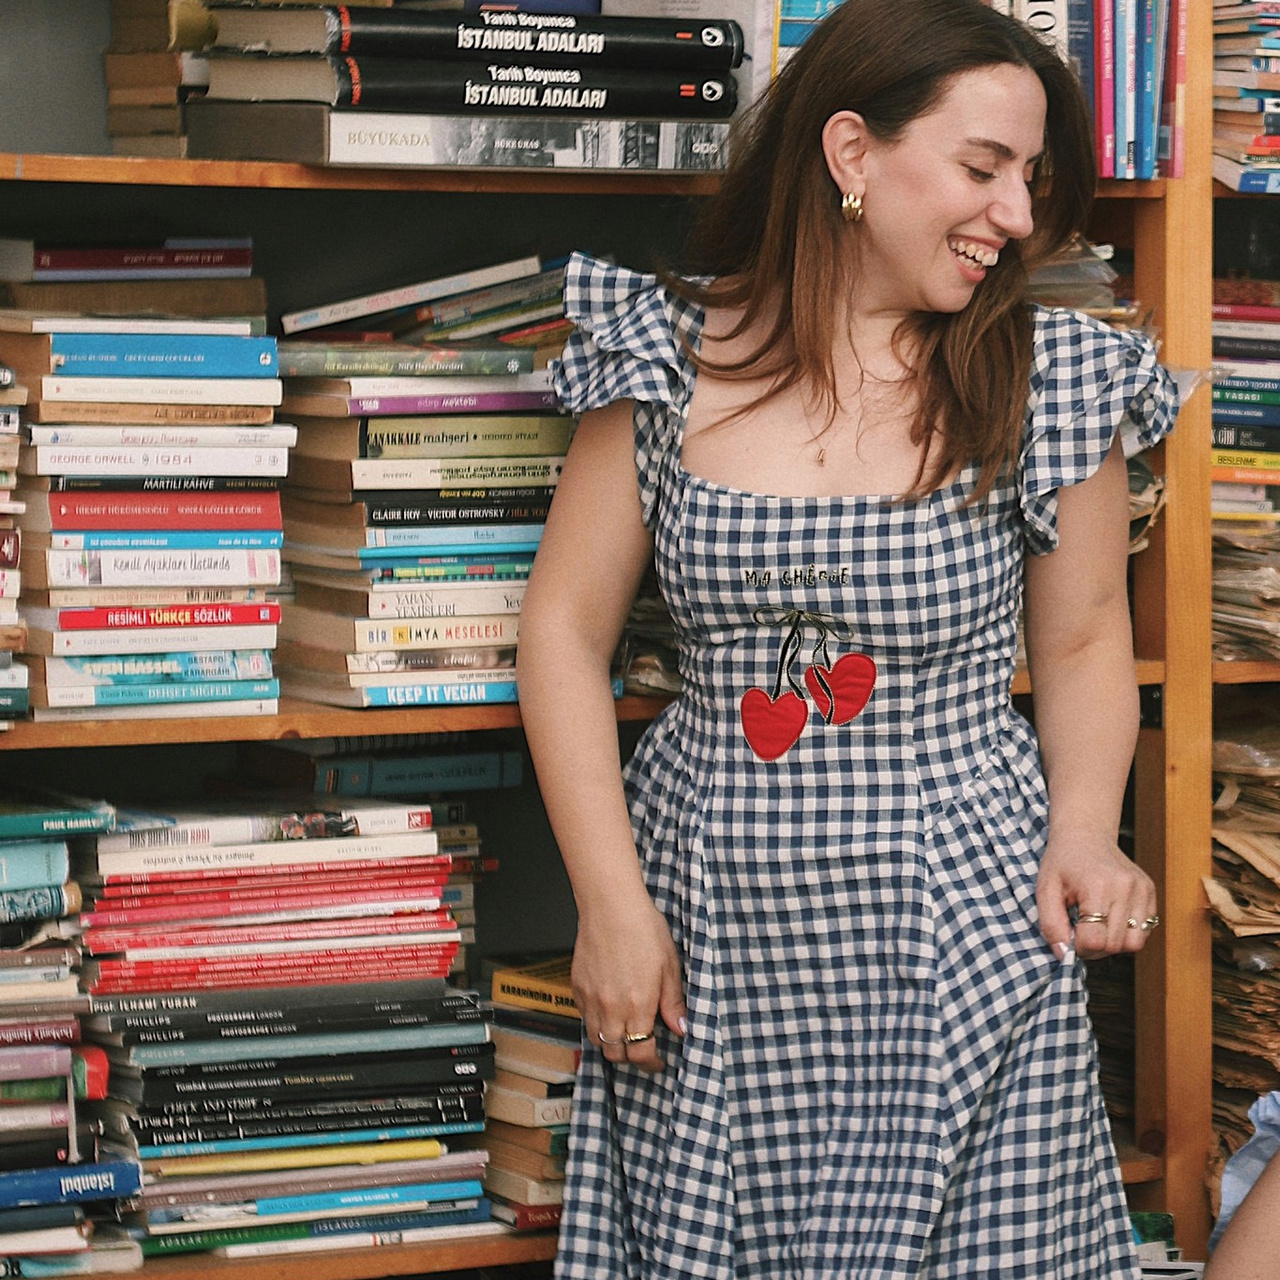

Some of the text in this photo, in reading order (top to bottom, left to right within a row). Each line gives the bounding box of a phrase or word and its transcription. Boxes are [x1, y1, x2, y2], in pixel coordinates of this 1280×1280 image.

[481, 11, 577, 31] Tarih Boyunca
[457, 25, 605, 53] İSTANBUL ADALARI
[488, 64, 581, 86] Tarih Boyunca
[464, 82, 607, 109] İSTANBUL ADALARI
[347, 131, 430, 148] BÜYÜKADA
[423, 431, 469, 446] mahşeri
[50, 454, 135, 465] GEORGE ORWELL
[155, 454, 193, 466] 1984
[1217, 455, 1257, 467] BESLENME
[373, 508, 402, 521] CLAIRE
[404, 508, 421, 520] HOY
[459, 508, 505, 519] OSTROVSKY
[745, 563, 850, 587] MA CHÉRIE
[394, 592, 433, 604] YABAN
[107, 608, 232, 626] RESİMLİ TÜRKÇE SÖZLÜK
[368, 629, 387, 643] BİR
[445, 623, 504, 640] MESELESİ
[187, 655, 224, 666] GESTAPO
[387, 685, 487, 704] KEEP IT VEGAN
[43, 819, 64, 831] PAUL
[129, 831, 146, 849] DAS
[501, 983, 552, 1003] KARAHİNDİBA
[161, 997, 197, 1010] TURAN
[126, 1016, 171, 1028] PHILLIPS
[139, 1031, 185, 1043] PHILLIPS
